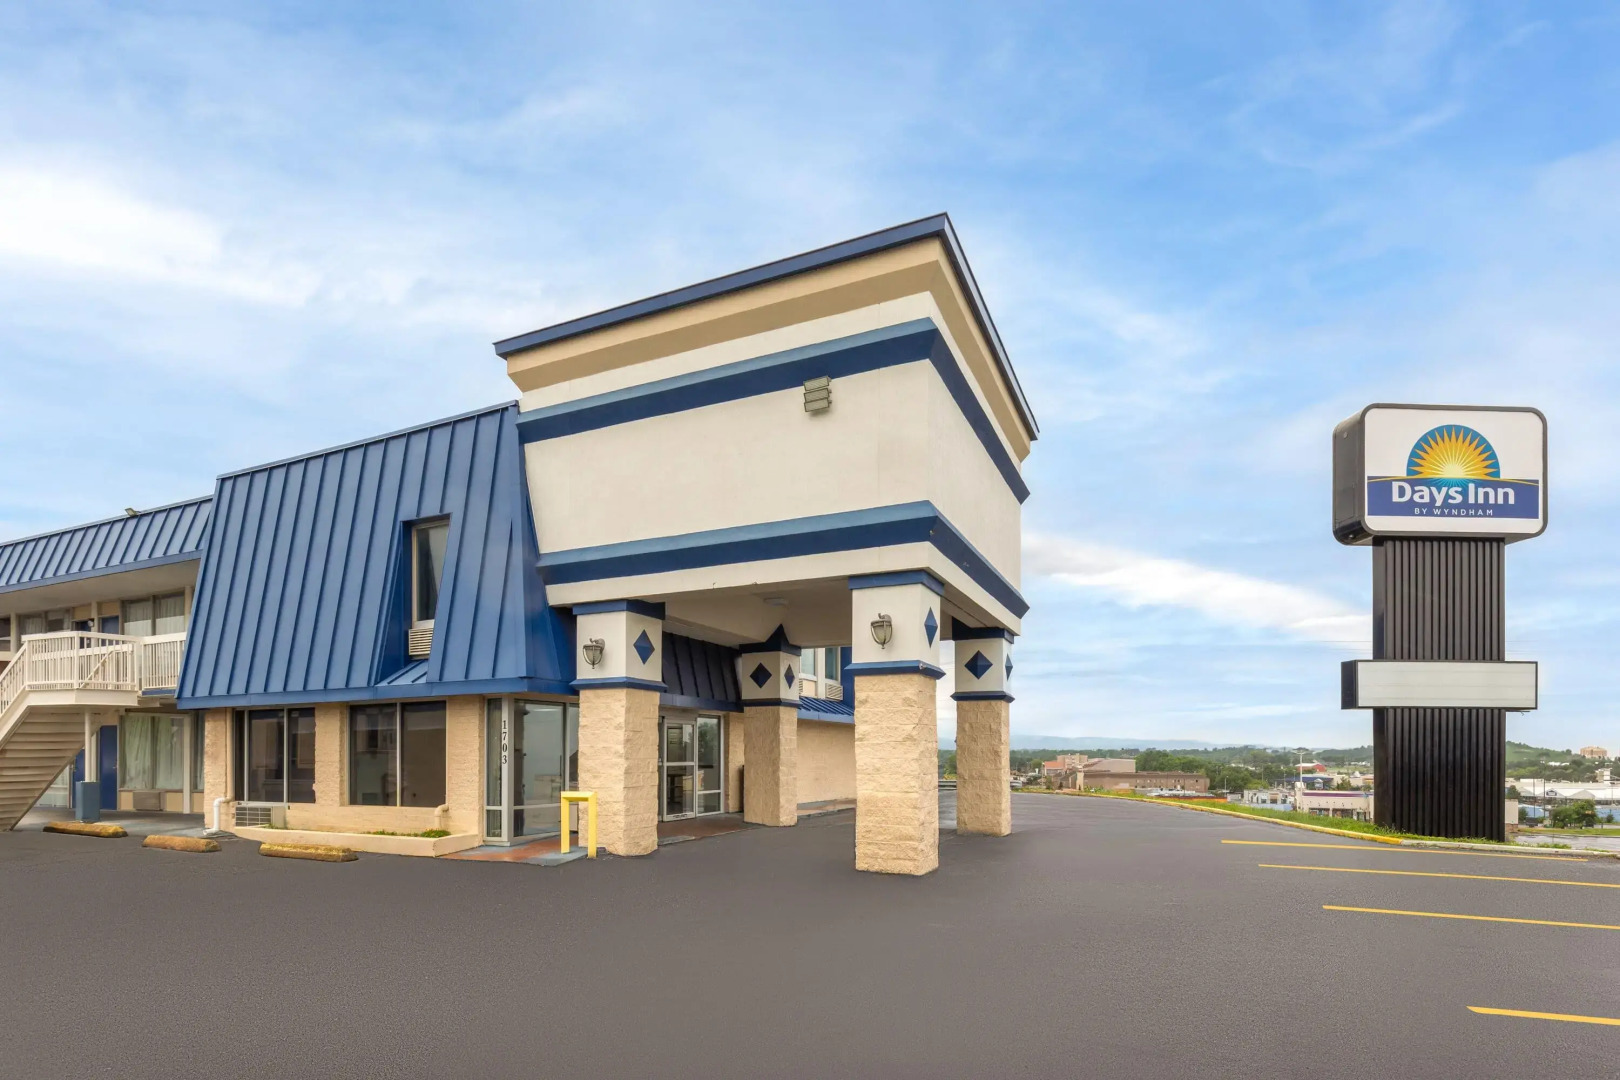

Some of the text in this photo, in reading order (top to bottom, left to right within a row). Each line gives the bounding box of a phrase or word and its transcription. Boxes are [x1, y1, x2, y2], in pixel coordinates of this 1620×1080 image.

[1392, 481, 1515, 506] Days Inn
[1433, 508, 1493, 516] WYNDHAM
